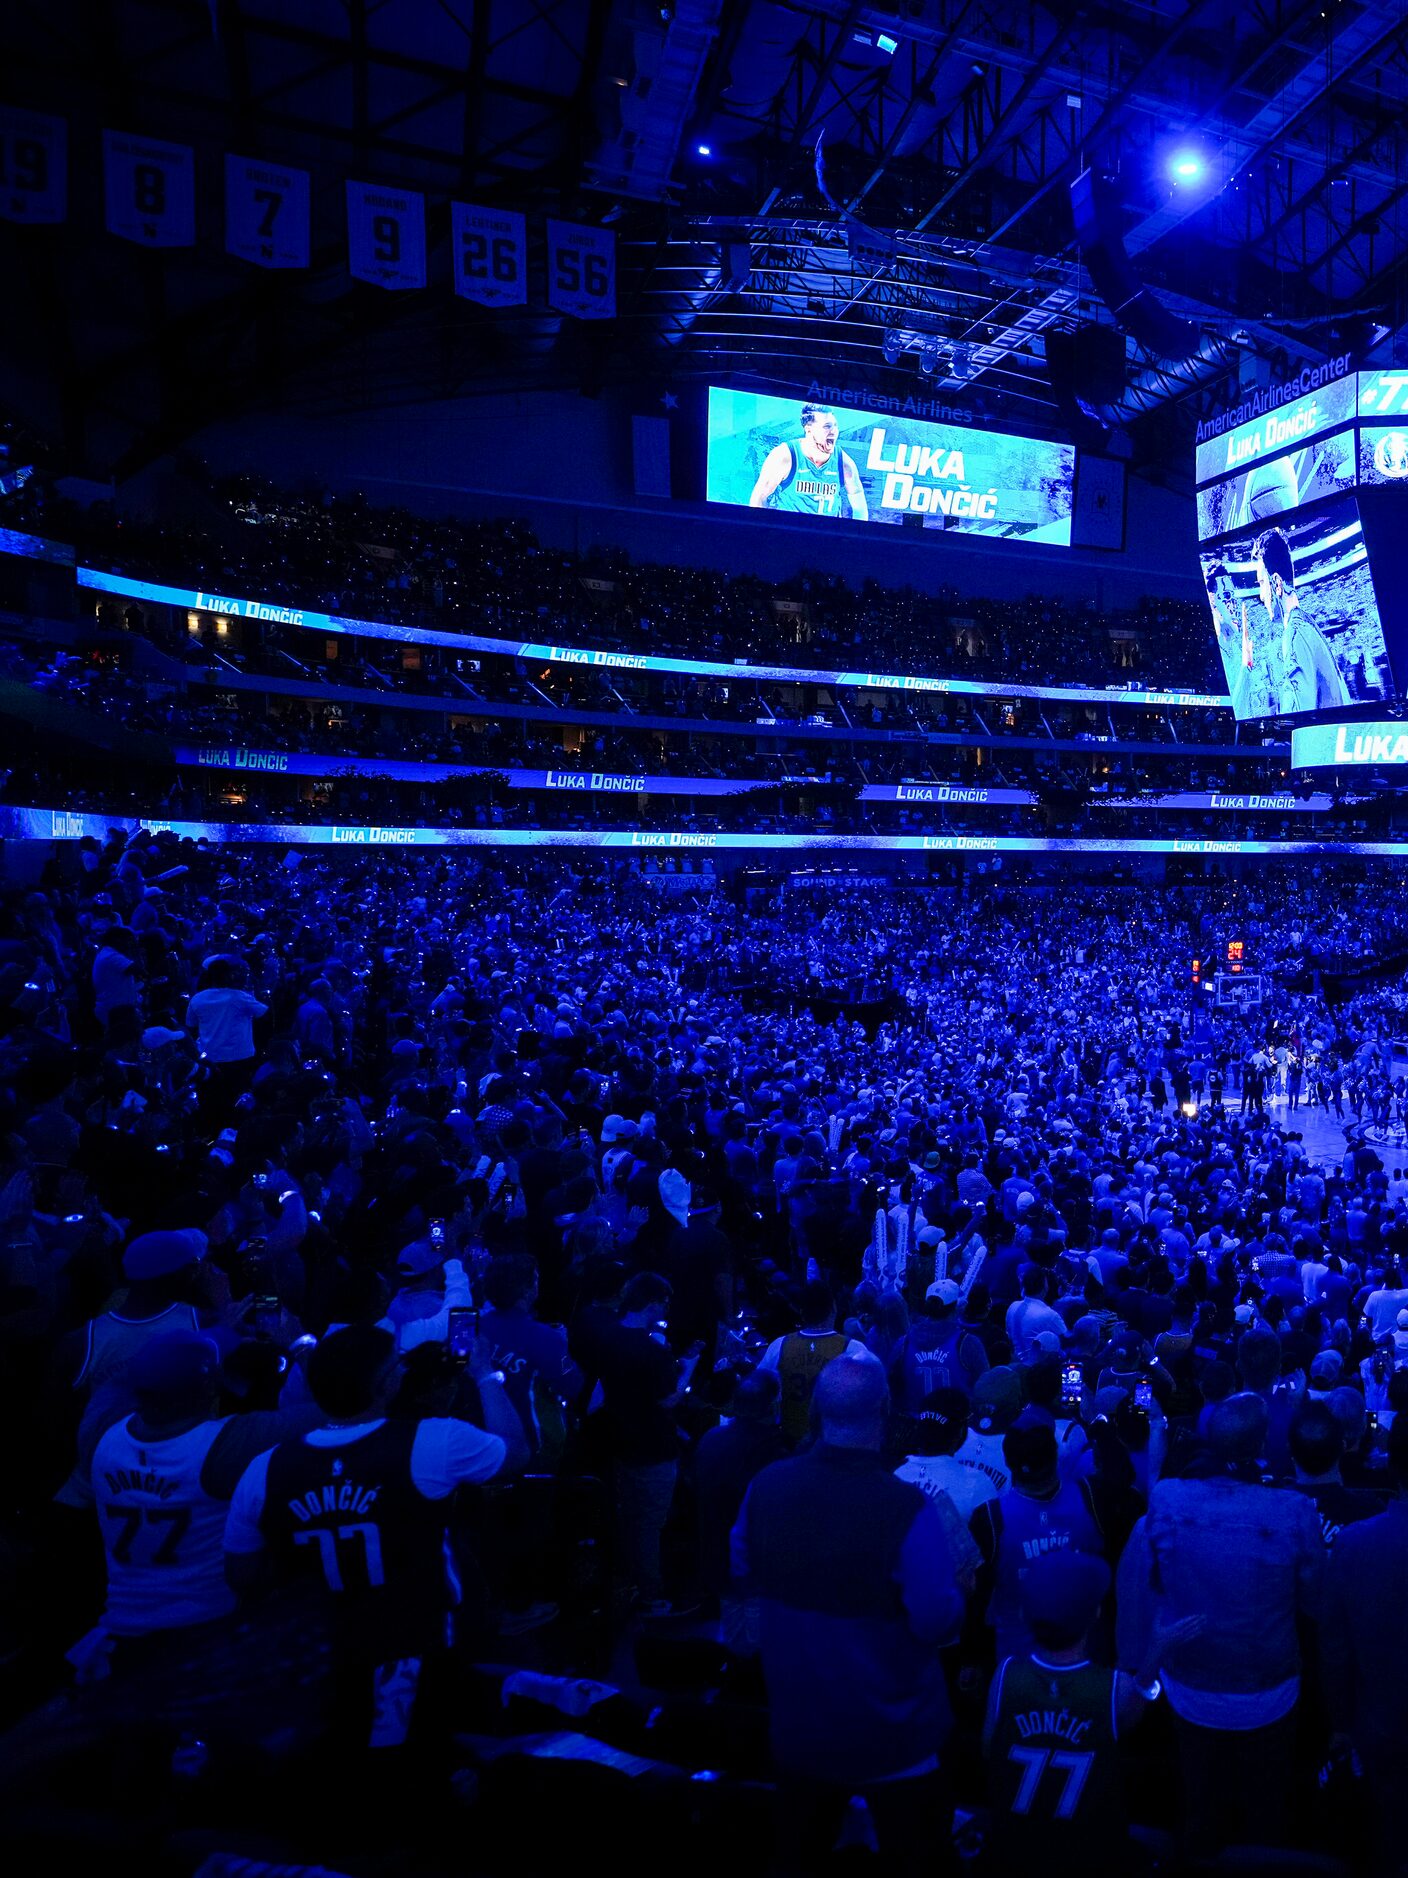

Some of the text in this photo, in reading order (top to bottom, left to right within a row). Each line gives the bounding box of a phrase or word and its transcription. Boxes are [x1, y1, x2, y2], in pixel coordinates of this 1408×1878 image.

[134, 164, 166, 215] 8
[254, 189, 282, 237] 7
[372, 215, 400, 261] 9
[462, 232, 517, 281] 26
[556, 249, 607, 297] 56
[807, 380, 974, 424] American Airlines
[866, 427, 965, 481] LUKA
[1227, 432, 1261, 466] LUKA
[881, 472, 998, 519] DONČIĆ
[196, 592, 239, 616] LUKA
[550, 647, 588, 665] LUKA
[545, 771, 585, 788] LUKA
[896, 785, 932, 800] LUKA
[1211, 794, 1244, 808] LUKA
[332, 826, 364, 842] LUKA
[632, 832, 665, 846] LUKA
[105, 1466, 180, 1500] DONČIĆ
[287, 1480, 383, 1523] DONČIĆ
[105, 1504, 193, 1566] 77
[292, 1522, 387, 1593] 77
[1014, 1707, 1094, 1744] DONČIĆ
[1007, 1743, 1099, 1822] 77
